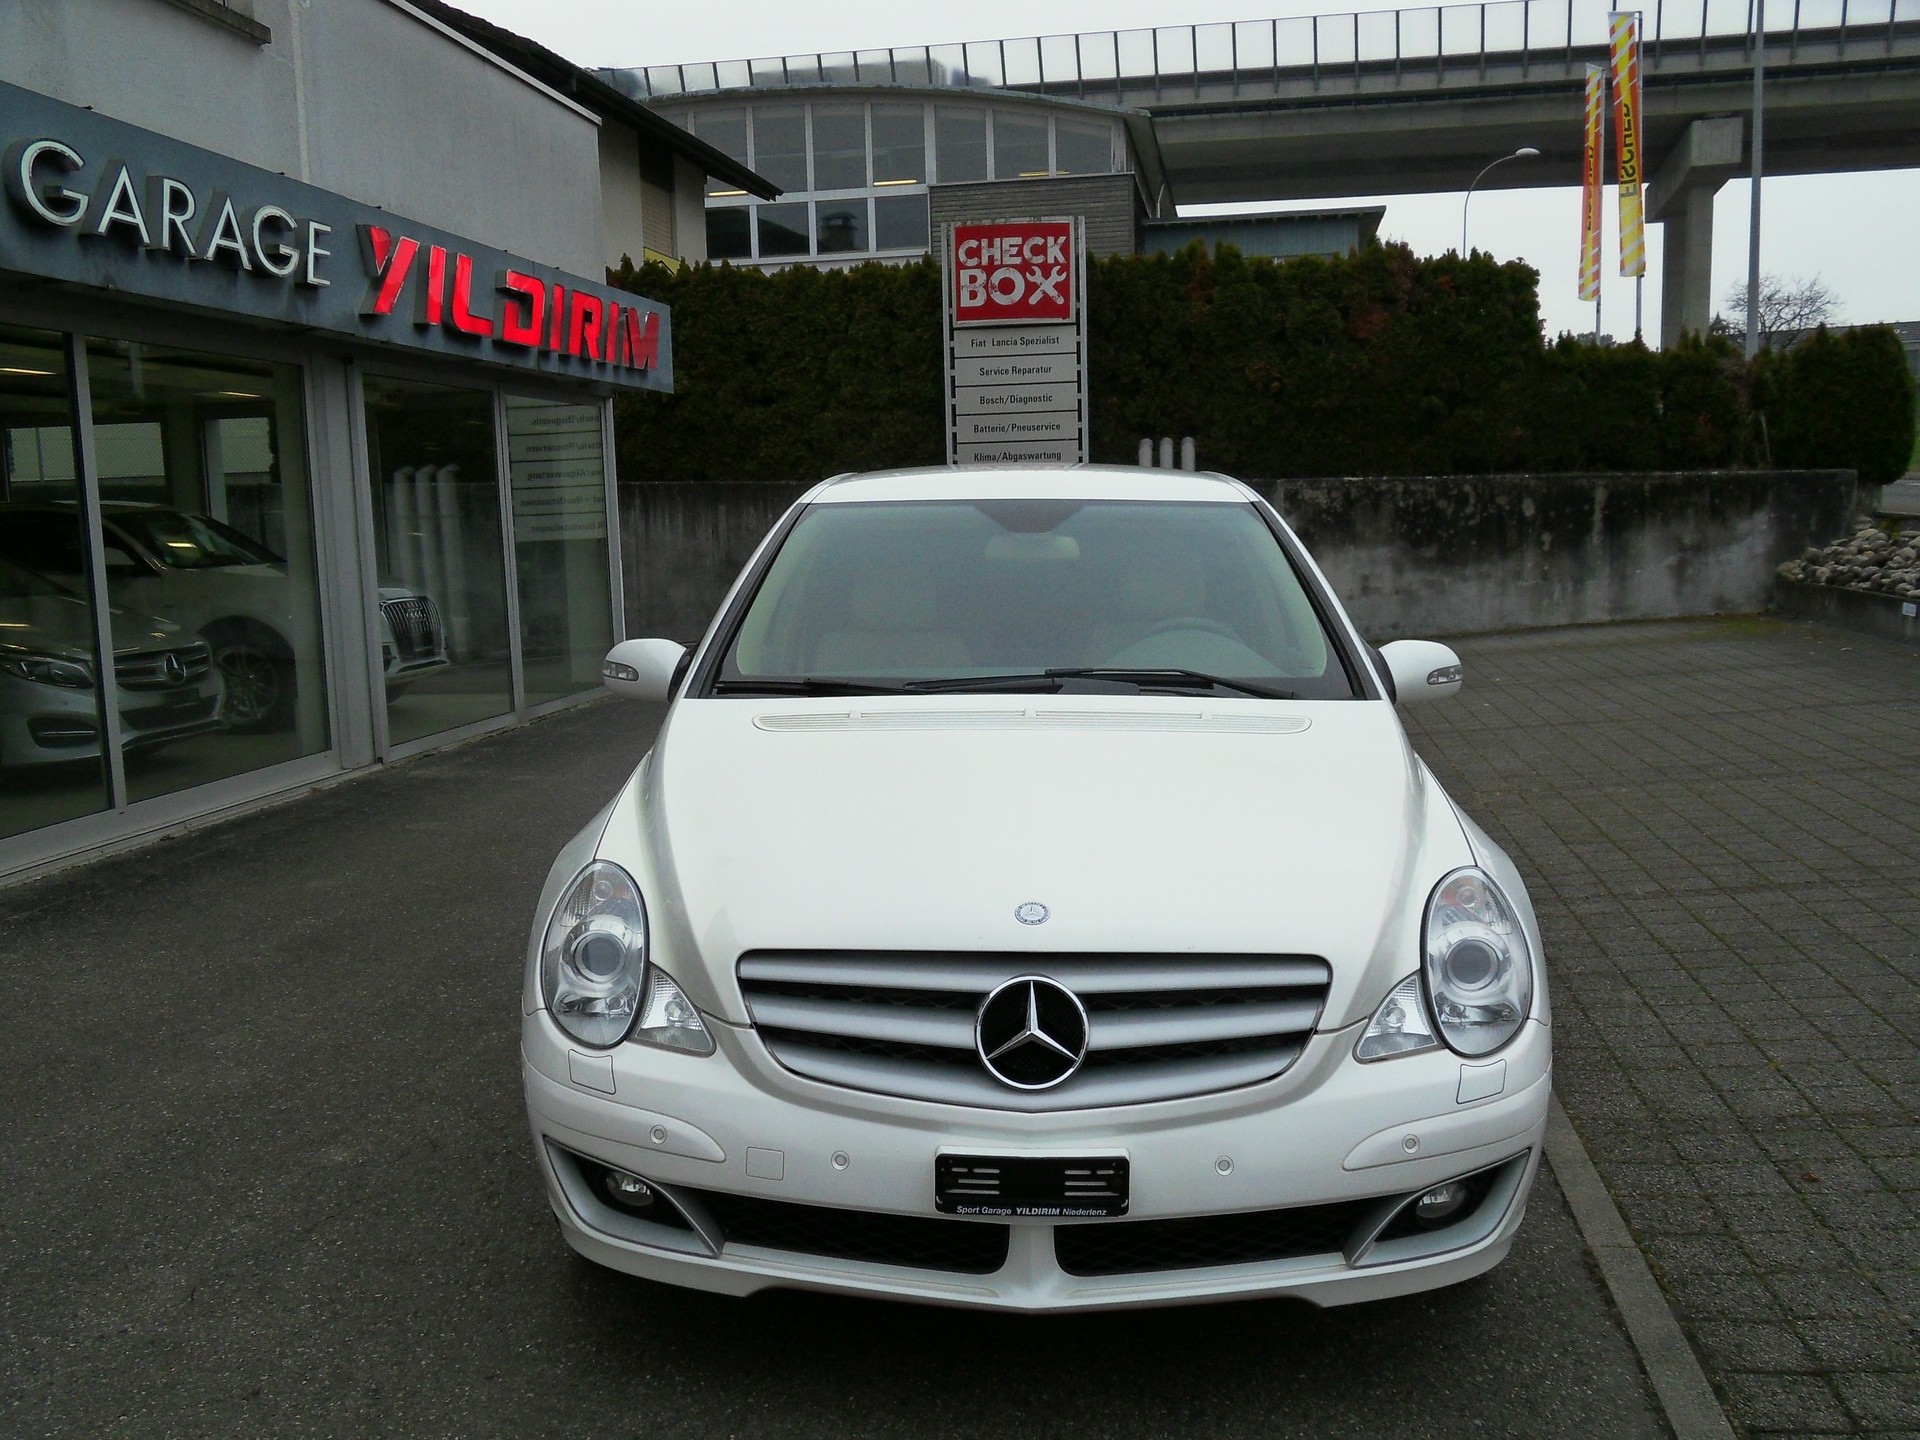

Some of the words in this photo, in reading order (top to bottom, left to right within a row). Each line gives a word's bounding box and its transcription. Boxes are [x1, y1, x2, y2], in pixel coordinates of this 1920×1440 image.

[12, 138, 332, 287] GARAGE
[357, 223, 659, 370] YILDIRIM
[958, 236, 1067, 267] CHECK
[960, 265, 1067, 308] BOX
[971, 338, 986, 348] Fiat
[992, 337, 1018, 347] Lancia
[1020, 336, 1060, 347] Spezialist
[979, 367, 1010, 377] Service
[1012, 365, 1052, 377] Reparatur
[979, 394, 1053, 406] Bosch/Diagnostic
[973, 422, 1061, 434] Batterie/Pneuservice
[974, 451, 1062, 463] Klima/Abgaswartung
[957, 1205, 980, 1216] Sport
[981, 1206, 1012, 1216] Garage
[1016, 1207, 1060, 1216] YILDIRIM
[1062, 1208, 1107, 1216] Niederlenz
